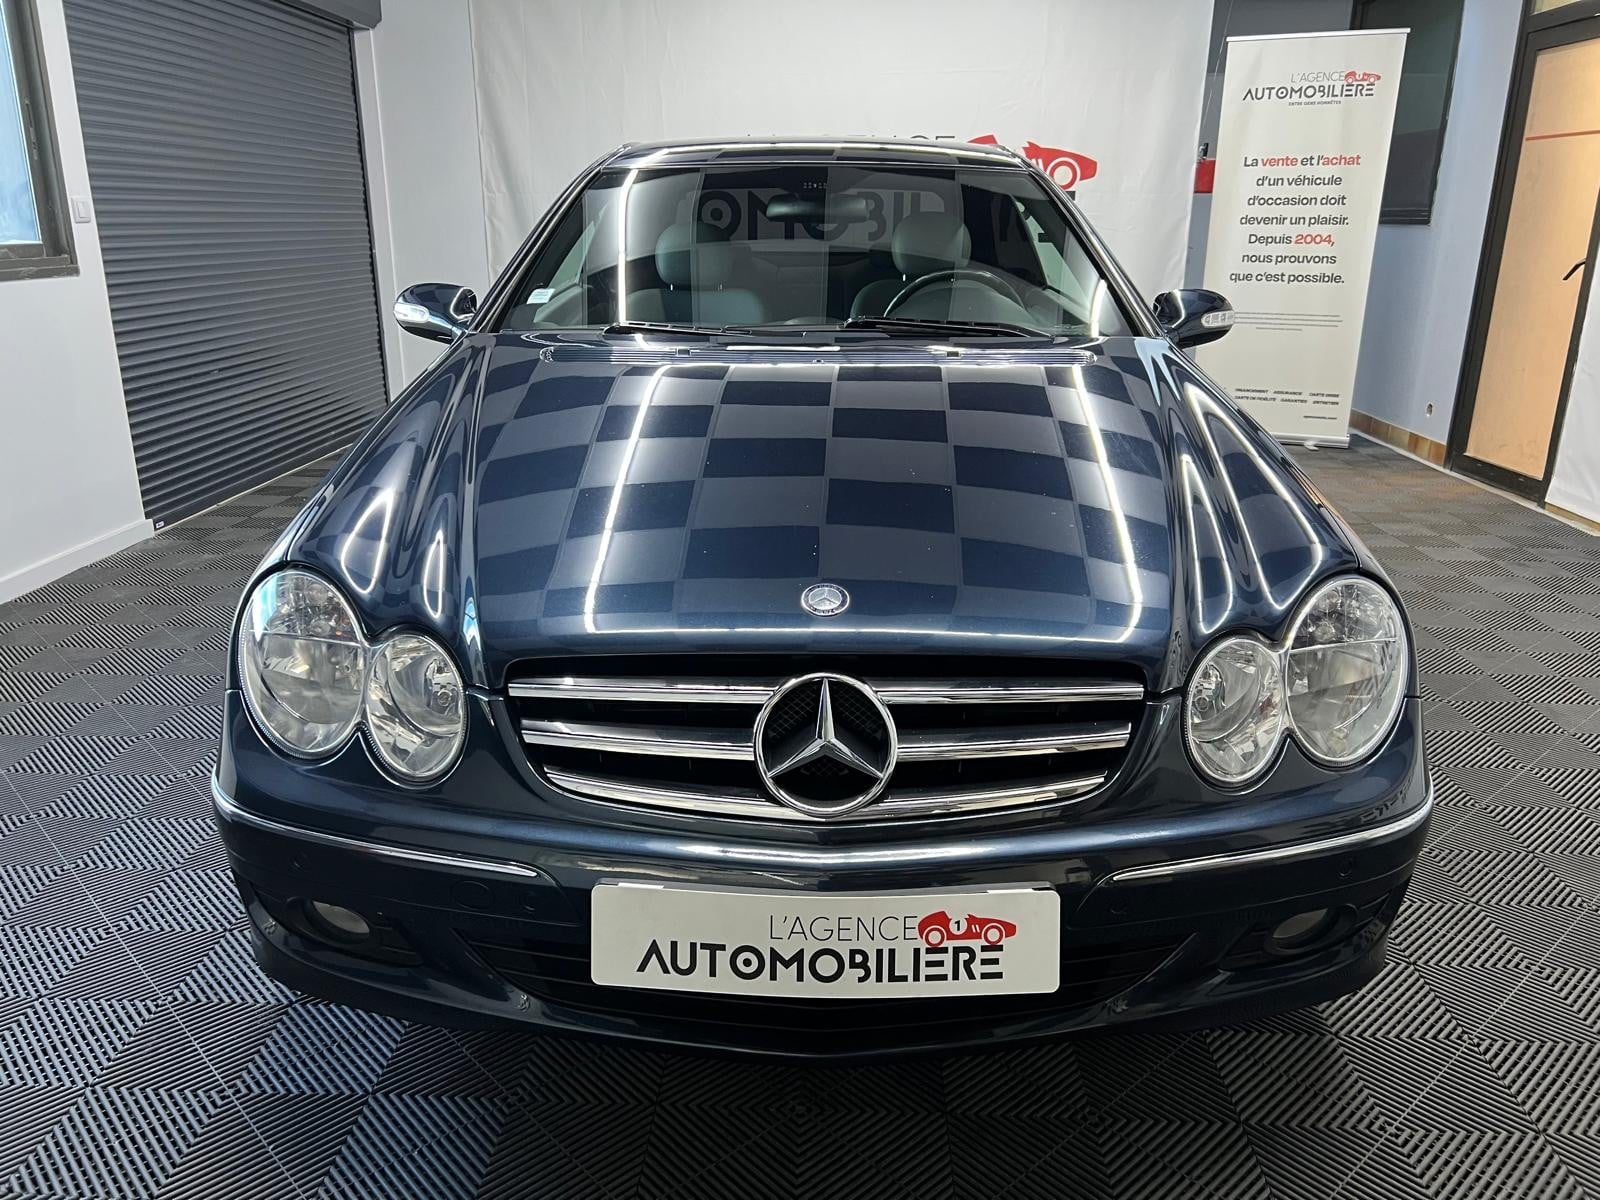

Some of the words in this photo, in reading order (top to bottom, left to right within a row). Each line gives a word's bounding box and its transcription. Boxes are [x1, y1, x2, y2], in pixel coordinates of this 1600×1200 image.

[1290, 71, 1345, 83] L'AGENCE
[1243, 156, 1259, 167] La
[1261, 156, 1298, 167] vente
[1300, 155, 1315, 166] et
[1316, 154, 1361, 166] l'achat
[1256, 175, 1284, 187] d'un
[1287, 174, 1342, 186] véhicule
[1247, 194, 1318, 206] d'occasion
[1320, 194, 1347, 206] doit
[1239, 215, 1288, 225] devenir
[1289, 216, 1306, 225] un
[1308, 214, 1349, 227] plaisir.
[1248, 233, 1292, 246] Depuis
[1294, 233, 1335, 247] 2004,
[1241, 254, 1273, 263] nous
[1274, 254, 1337, 265] prouvons
[1229, 273, 1253, 283] que
[1255, 272, 1286, 282] c'est
[1287, 272, 1345, 284] possible.
[769, 914, 918, 942] L'AGENCE
